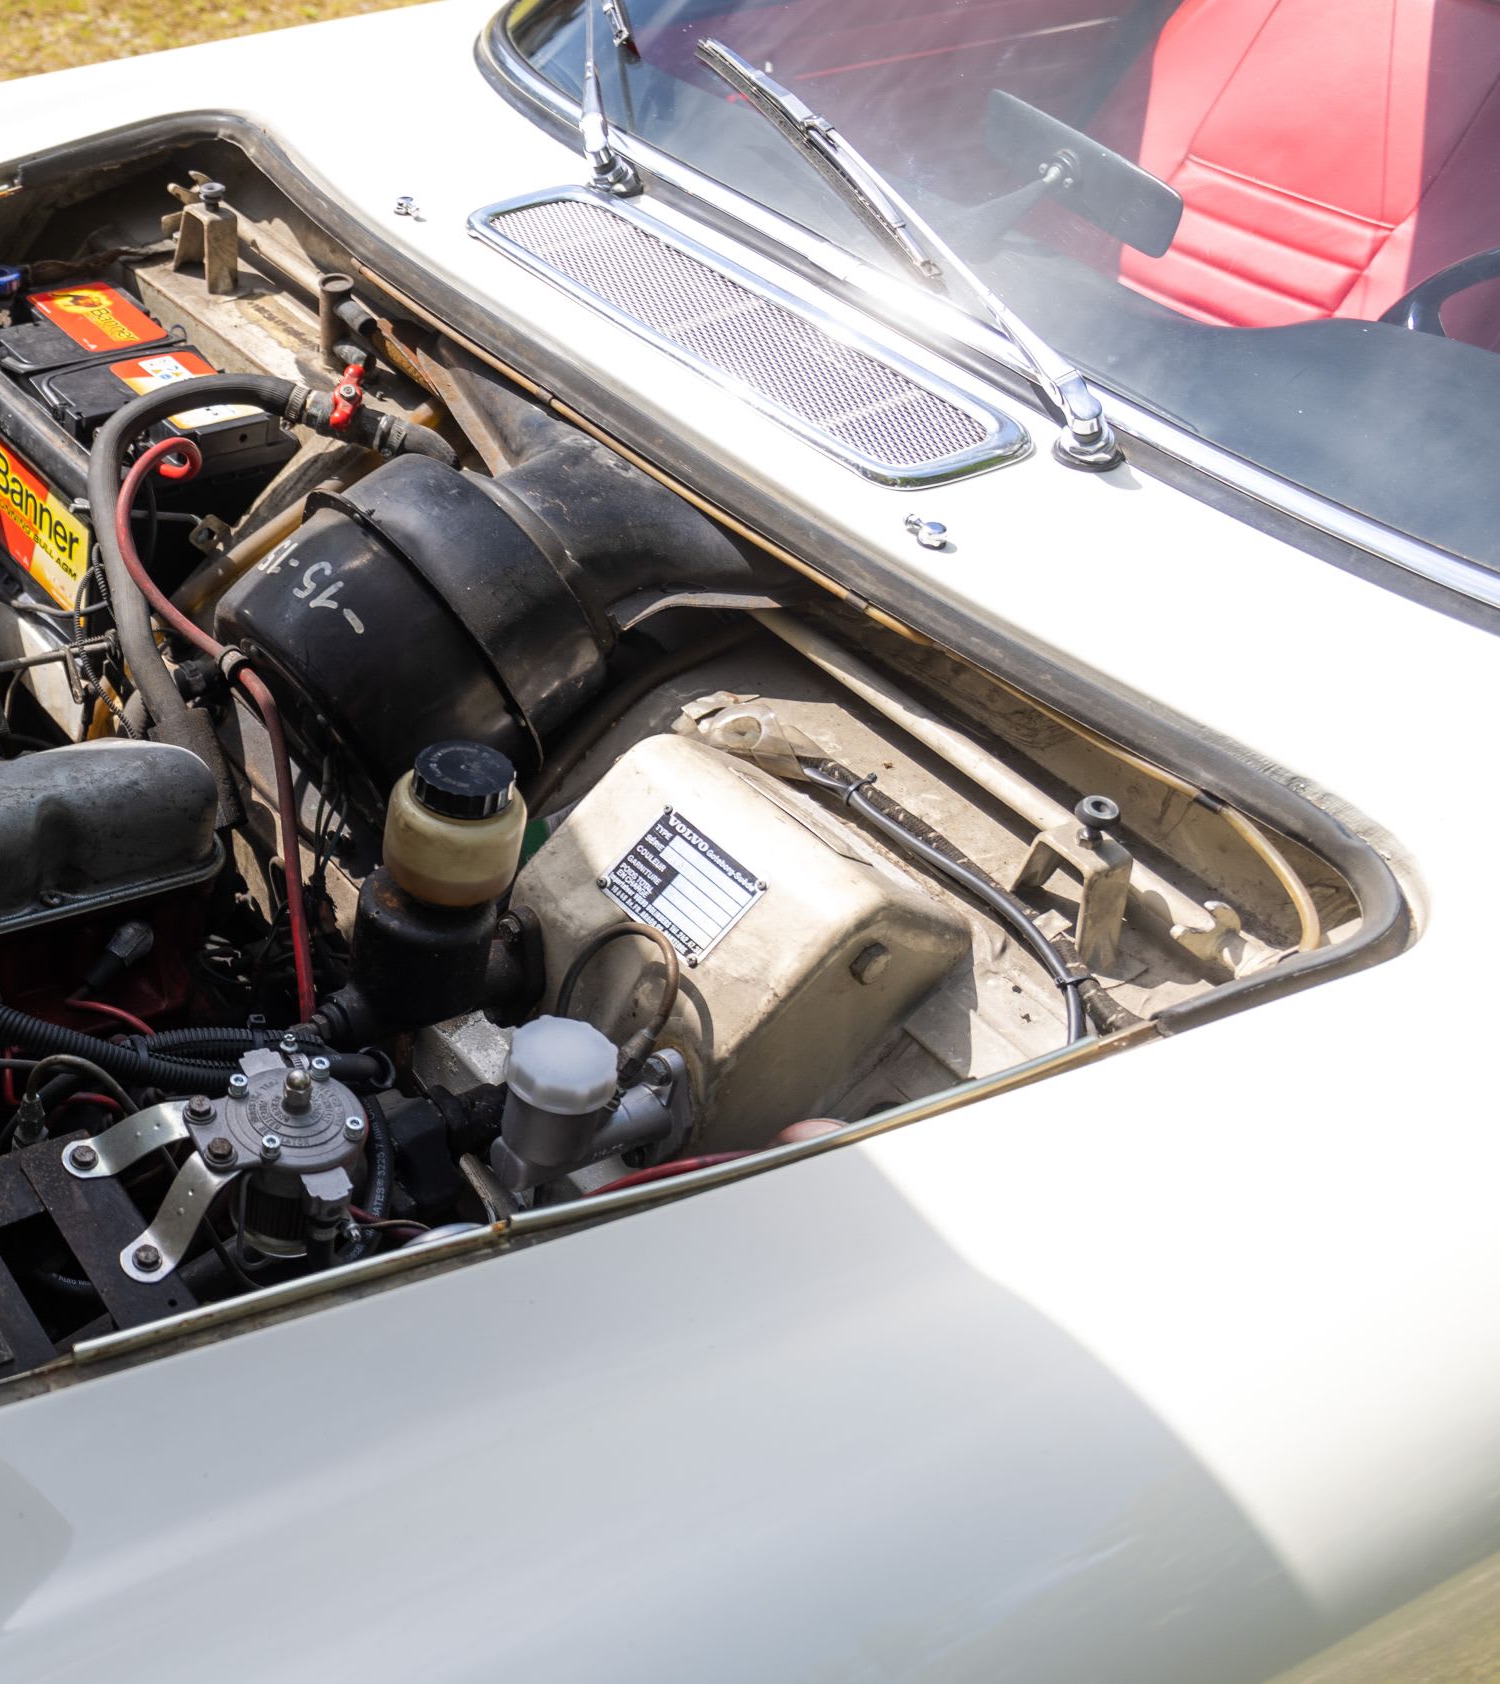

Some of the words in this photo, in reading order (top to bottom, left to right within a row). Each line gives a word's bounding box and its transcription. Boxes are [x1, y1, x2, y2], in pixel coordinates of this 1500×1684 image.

[91, 307, 136, 341] Banner
[33, 534, 54, 560] BULL
[56, 557, 78, 581] AGM
[655, 824, 673, 840] TYPE
[668, 813, 709, 852] VOLVO
[627, 854, 662, 886] GARNITURE
[636, 845, 667, 872] COULEUR
[616, 868, 627, 881] EN
[625, 876, 650, 899] CHARGE
[619, 862, 640, 881] POIDS
[637, 876, 655, 894] TOTAL
